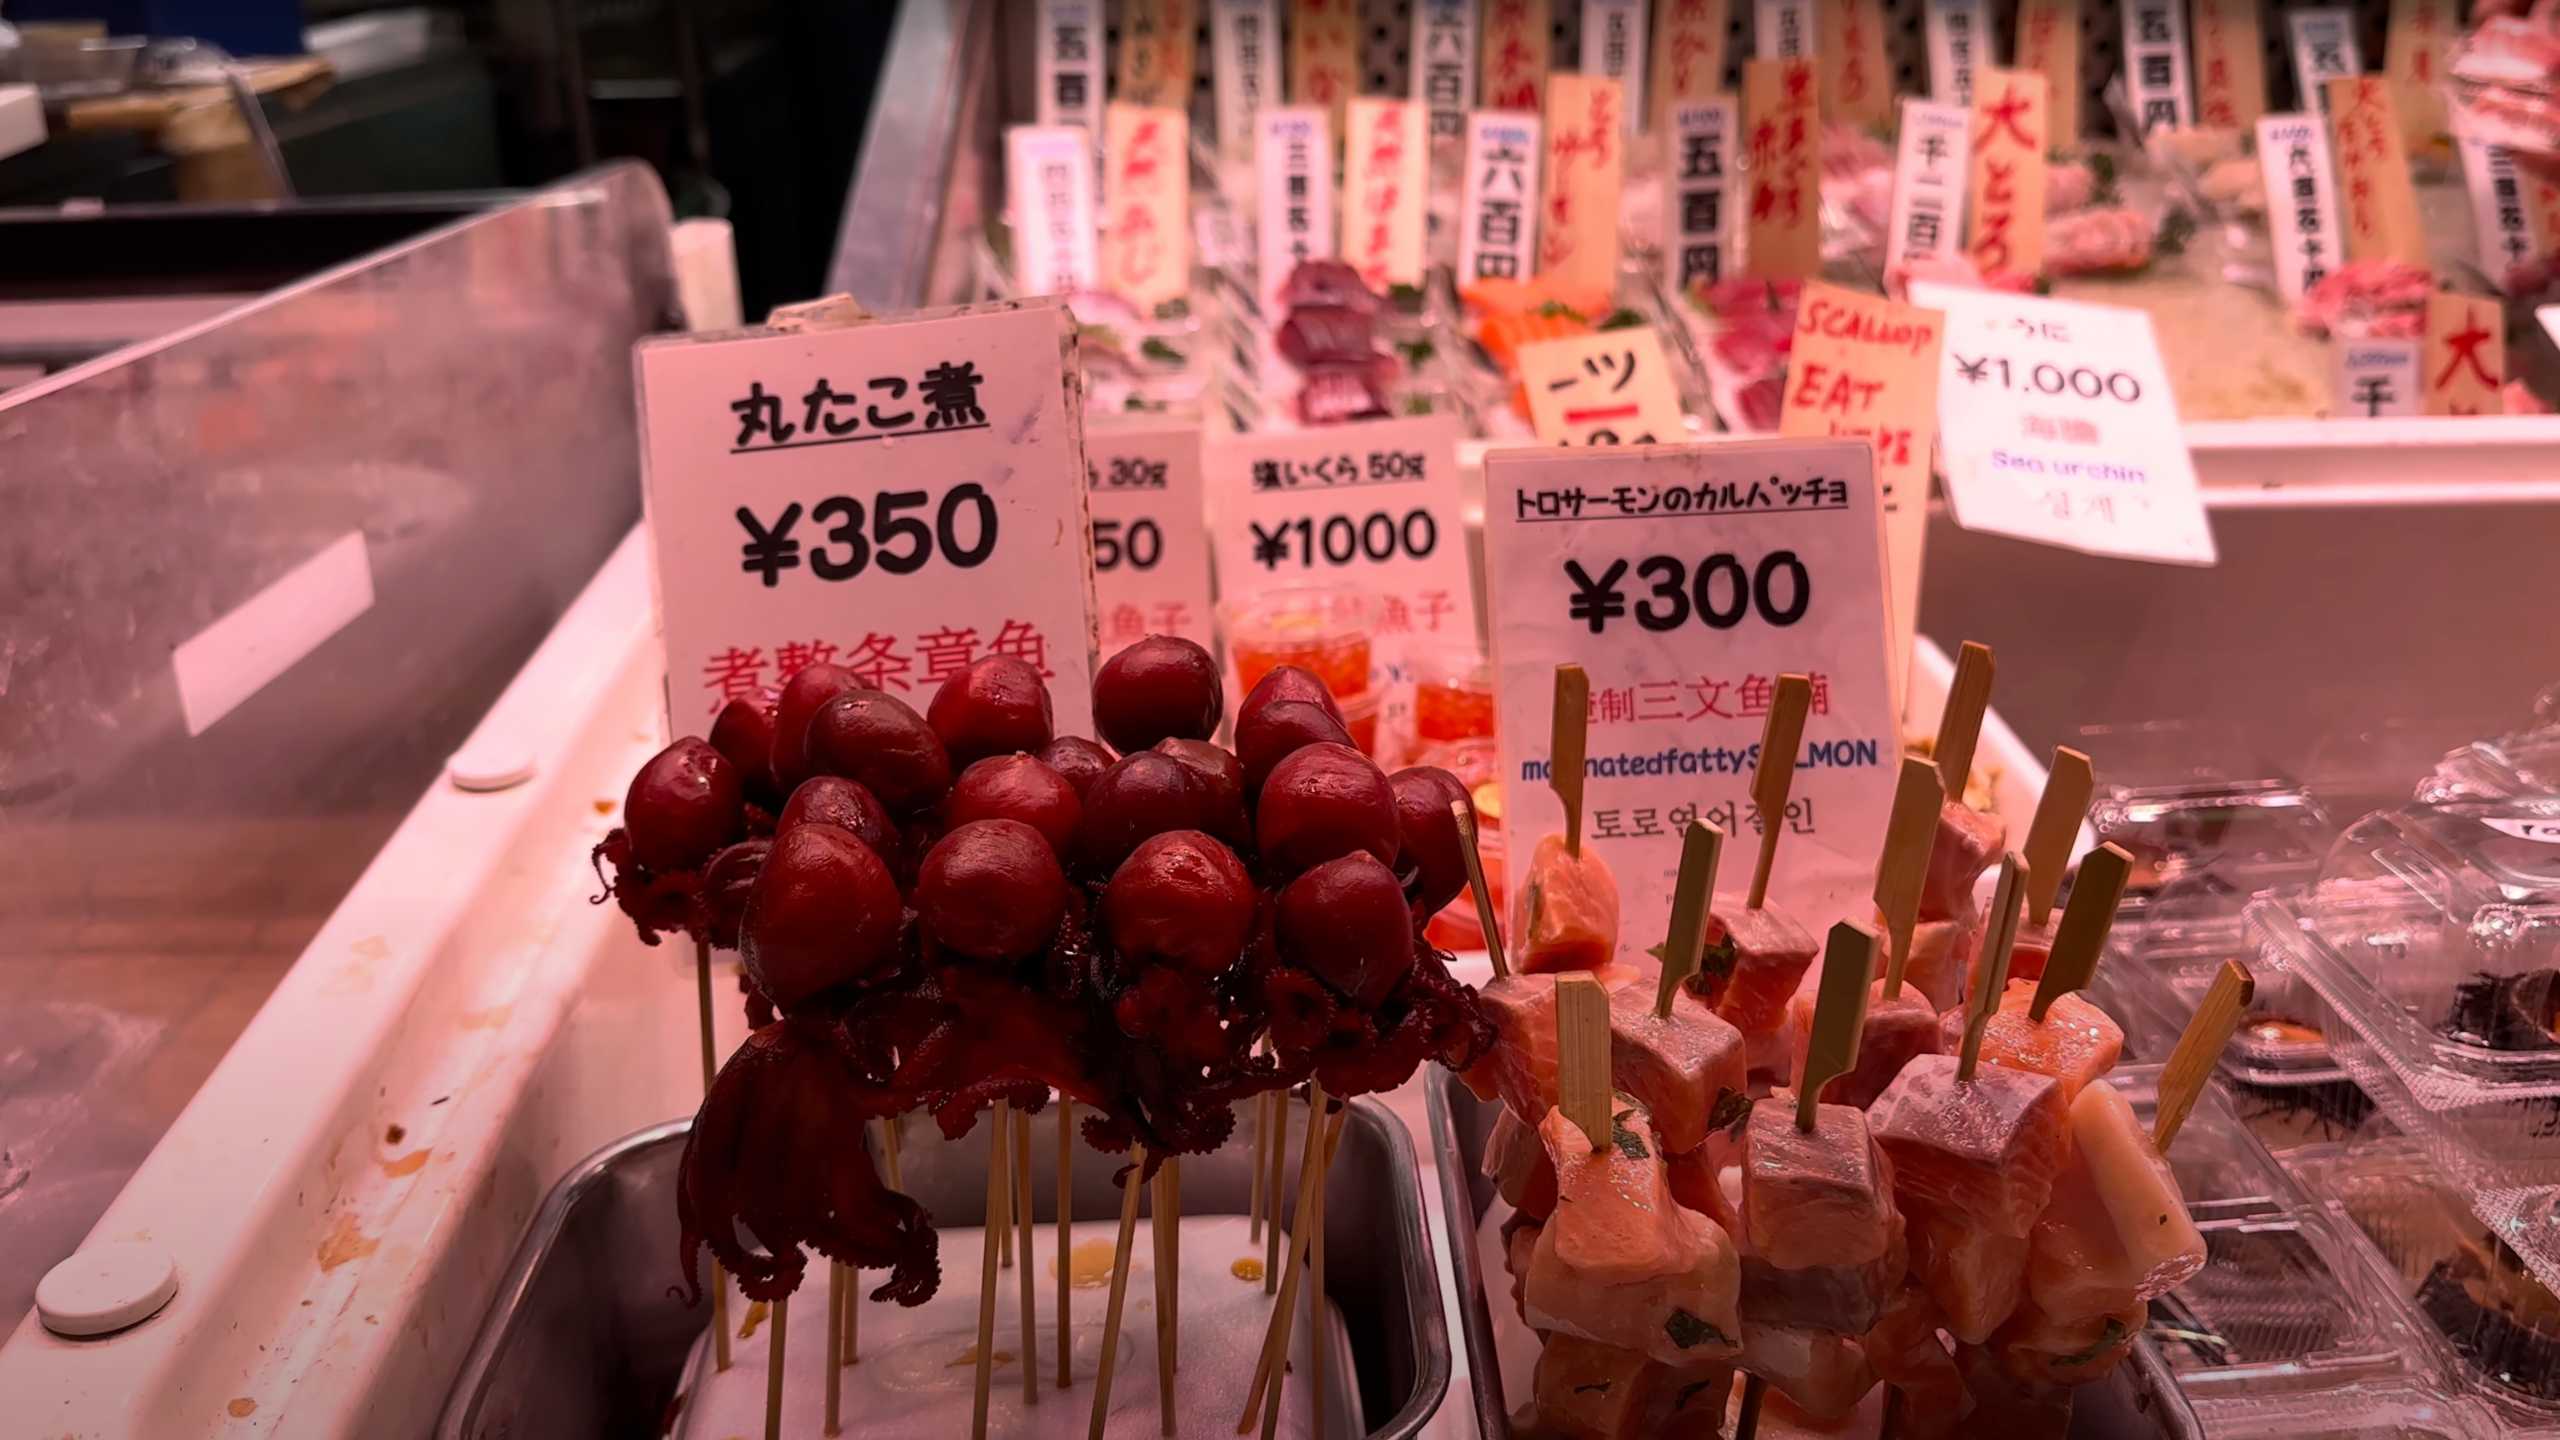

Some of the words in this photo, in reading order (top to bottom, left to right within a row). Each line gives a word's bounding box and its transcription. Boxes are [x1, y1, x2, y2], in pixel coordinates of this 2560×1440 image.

[1679, 134, 1722, 291] 五百円
[1904, 134, 1950, 260] 千二百
[1974, 84, 2036, 276] 大とろ
[1792, 364, 1885, 415] EAT
[2434, 306, 2500, 414] 大
[730, 361, 986, 447] 丸たこ煮
[1109, 457, 1168, 488] 30g
[1252, 457, 1358, 488] 塩いくら
[1367, 451, 1425, 483] 50g
[1516, 477, 1848, 519] トロサーモンのカルパッチョ
[735, 483, 998, 588] ¥350
[1250, 509, 1437, 571] ¥1000
[1563, 550, 1811, 634] ¥300
